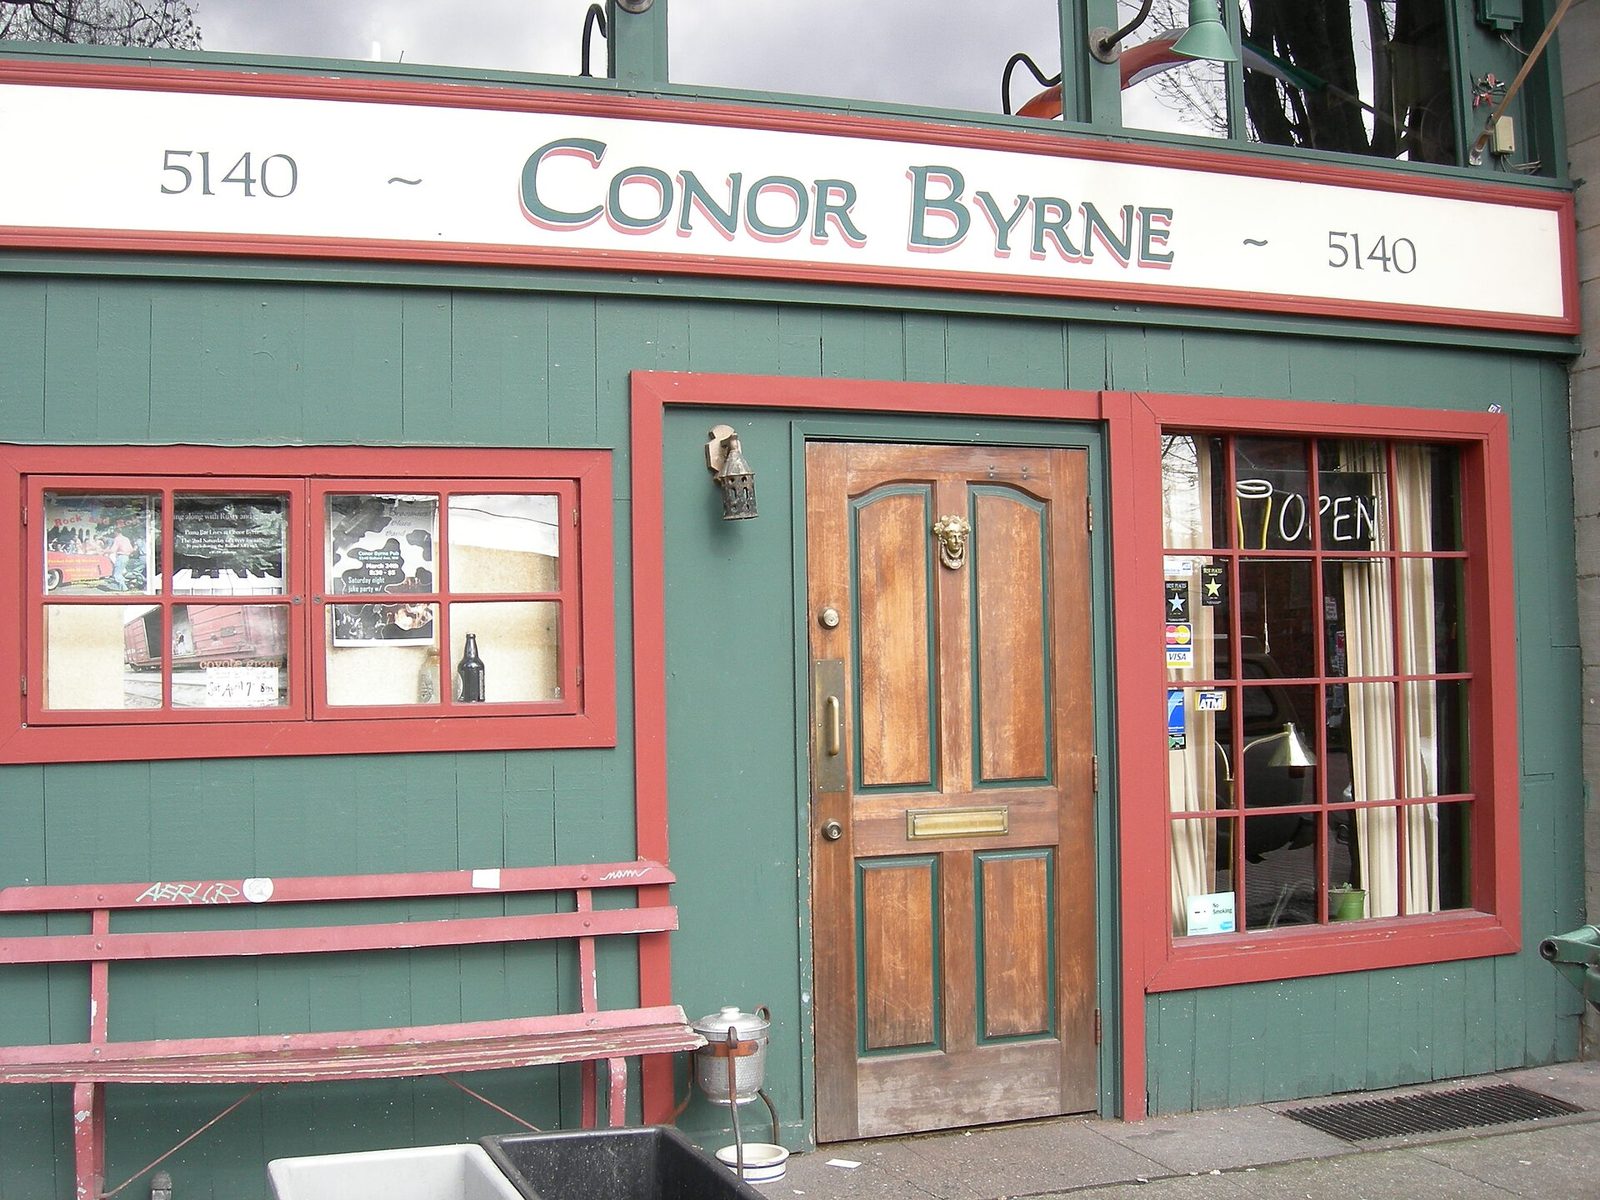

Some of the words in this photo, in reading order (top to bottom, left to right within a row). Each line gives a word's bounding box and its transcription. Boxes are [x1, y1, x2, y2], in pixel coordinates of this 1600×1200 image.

[160, 149, 298, 198] 5140
[1328, 231, 1417, 274] 5140
[1279, 493, 1378, 542] OPEN
[348, 576, 371, 584] Saturday
[371, 576, 385, 584] night
[1168, 653, 1187, 661] VISA
[199, 658, 243, 669] coyote
[1200, 698, 1223, 709] ATM
